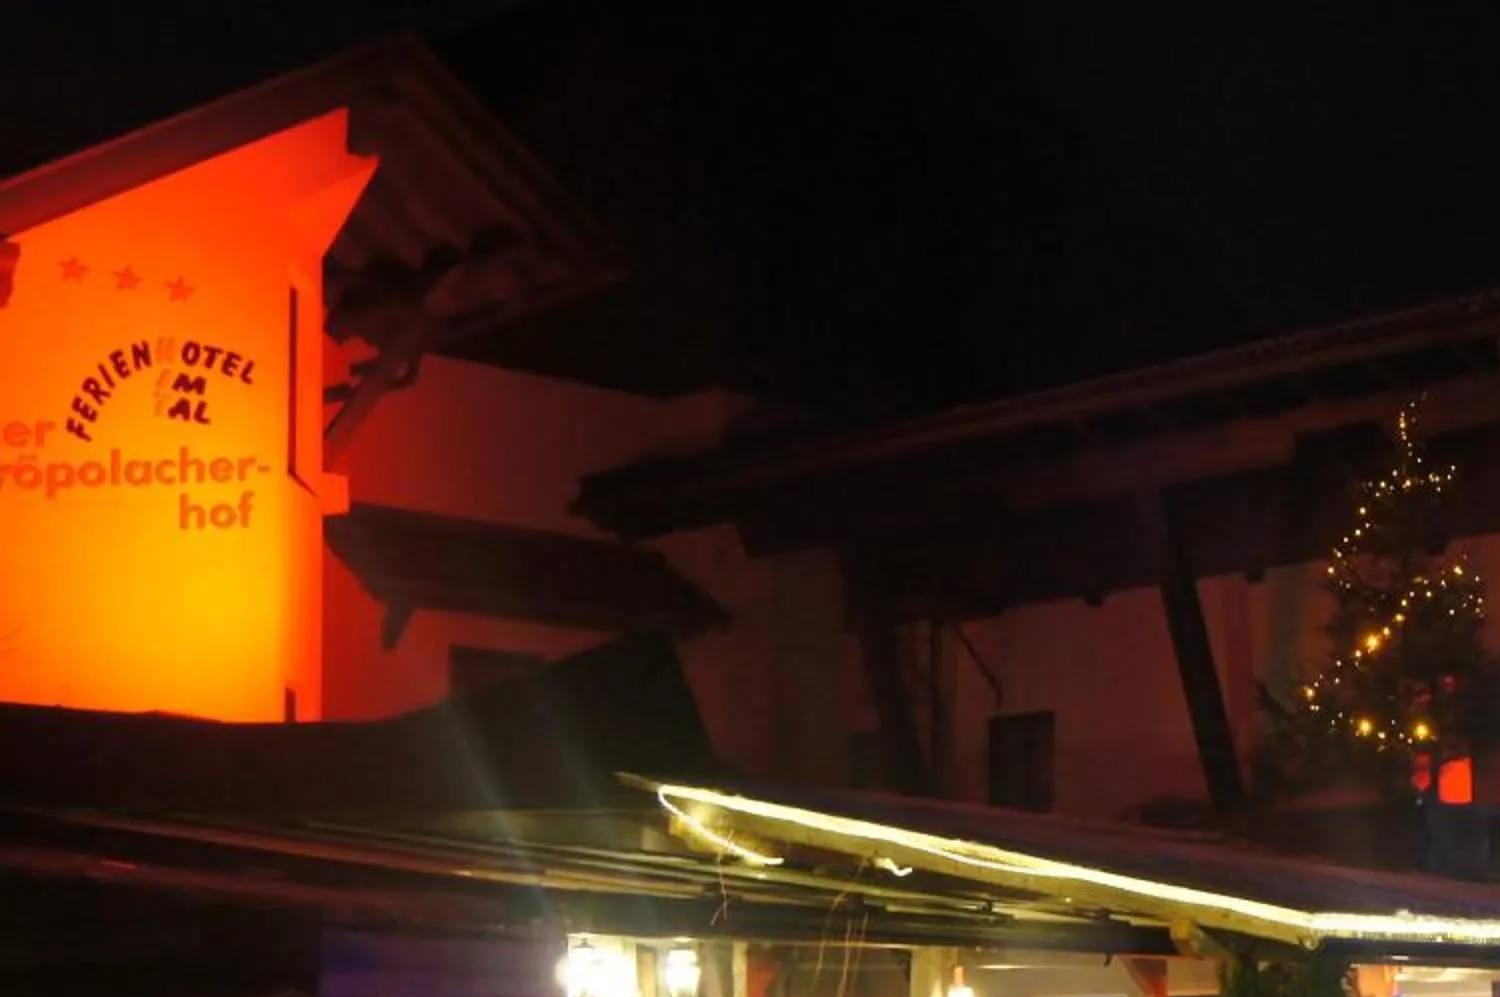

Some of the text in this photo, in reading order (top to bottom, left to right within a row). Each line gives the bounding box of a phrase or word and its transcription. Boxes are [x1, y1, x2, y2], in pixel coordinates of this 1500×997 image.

[3, 420, 56, 448] er
[0, 447, 270, 498] röpolacher-
[178, 490, 255, 531] hof
